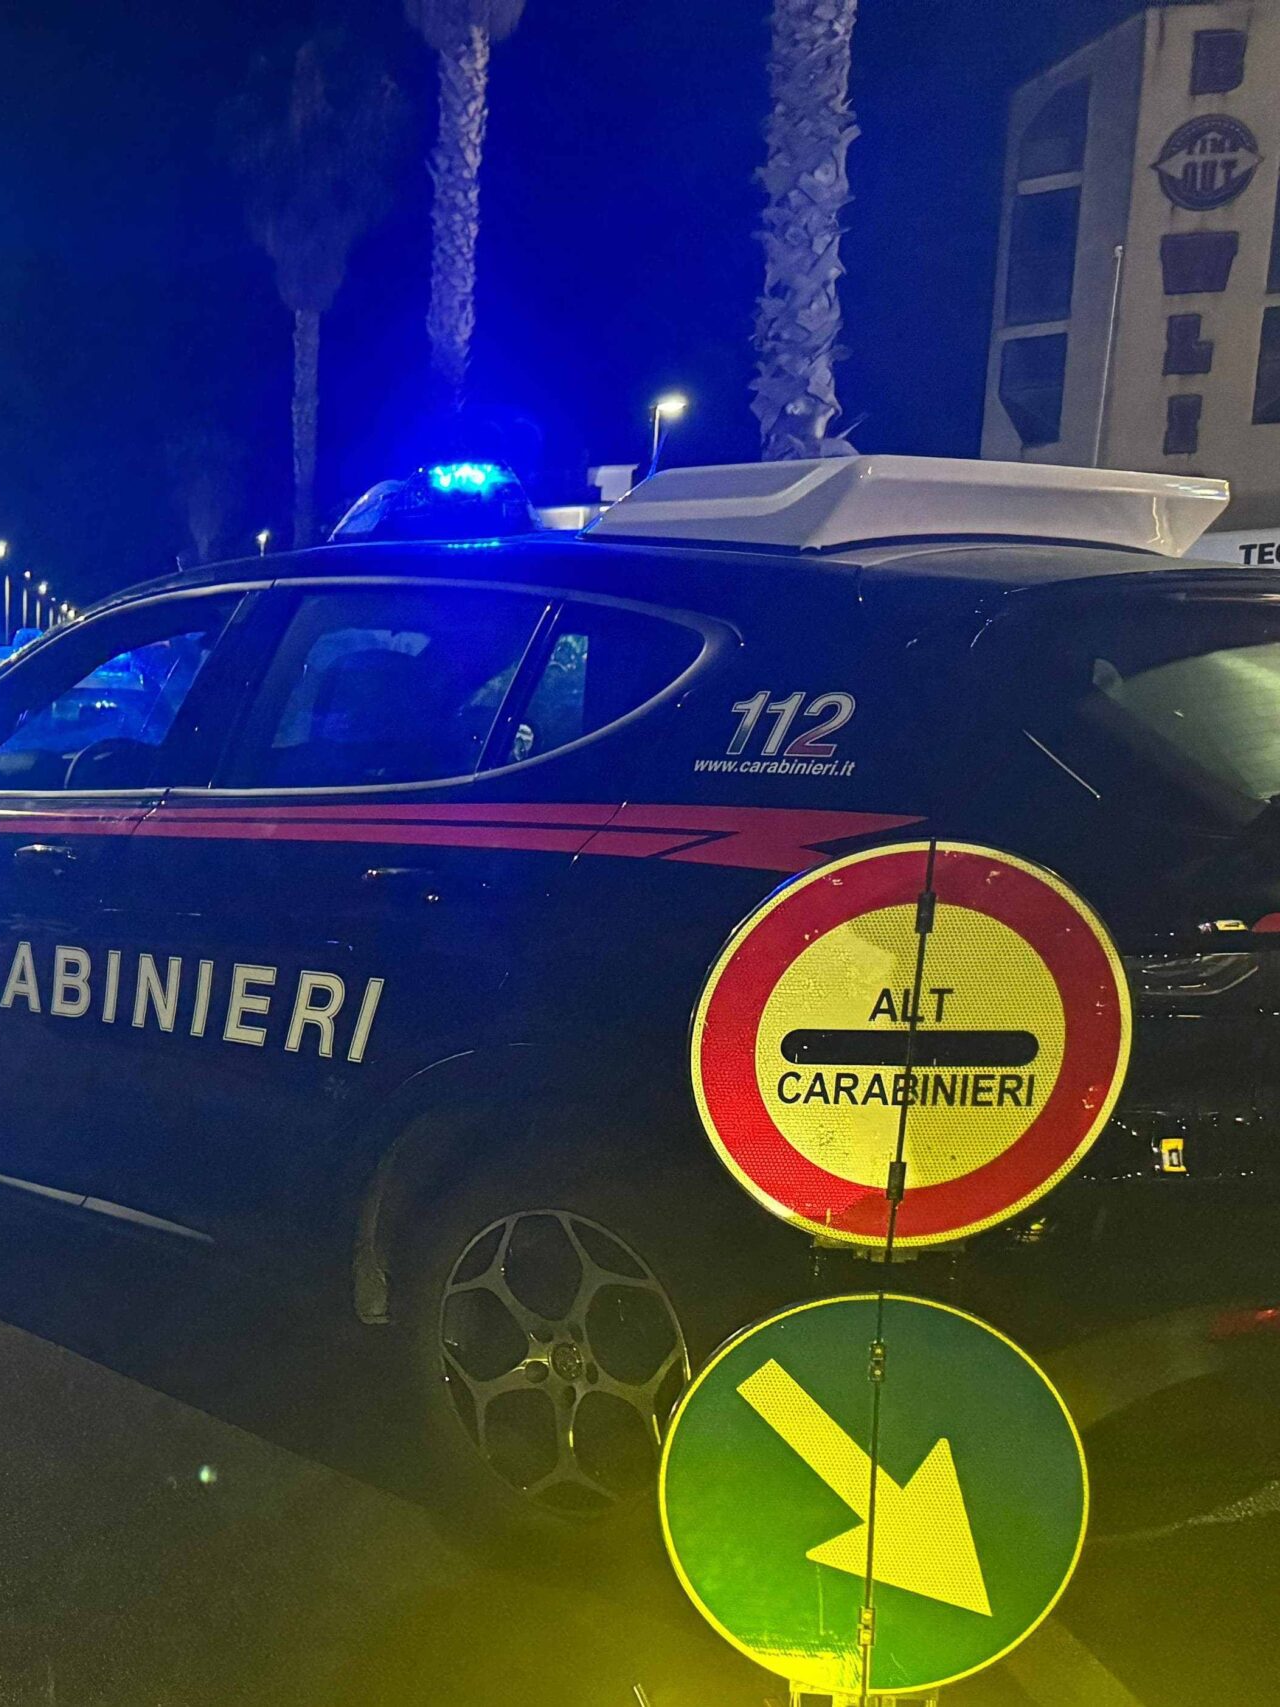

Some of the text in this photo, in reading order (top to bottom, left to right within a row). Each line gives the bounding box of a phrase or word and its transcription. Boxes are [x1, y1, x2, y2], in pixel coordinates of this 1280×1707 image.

[726, 691, 856, 757] 112
[694, 759, 856, 777] www.carabinieri.it
[868, 987, 955, 1023] ALT
[777, 1071, 1035, 1107] CARABINIERI
